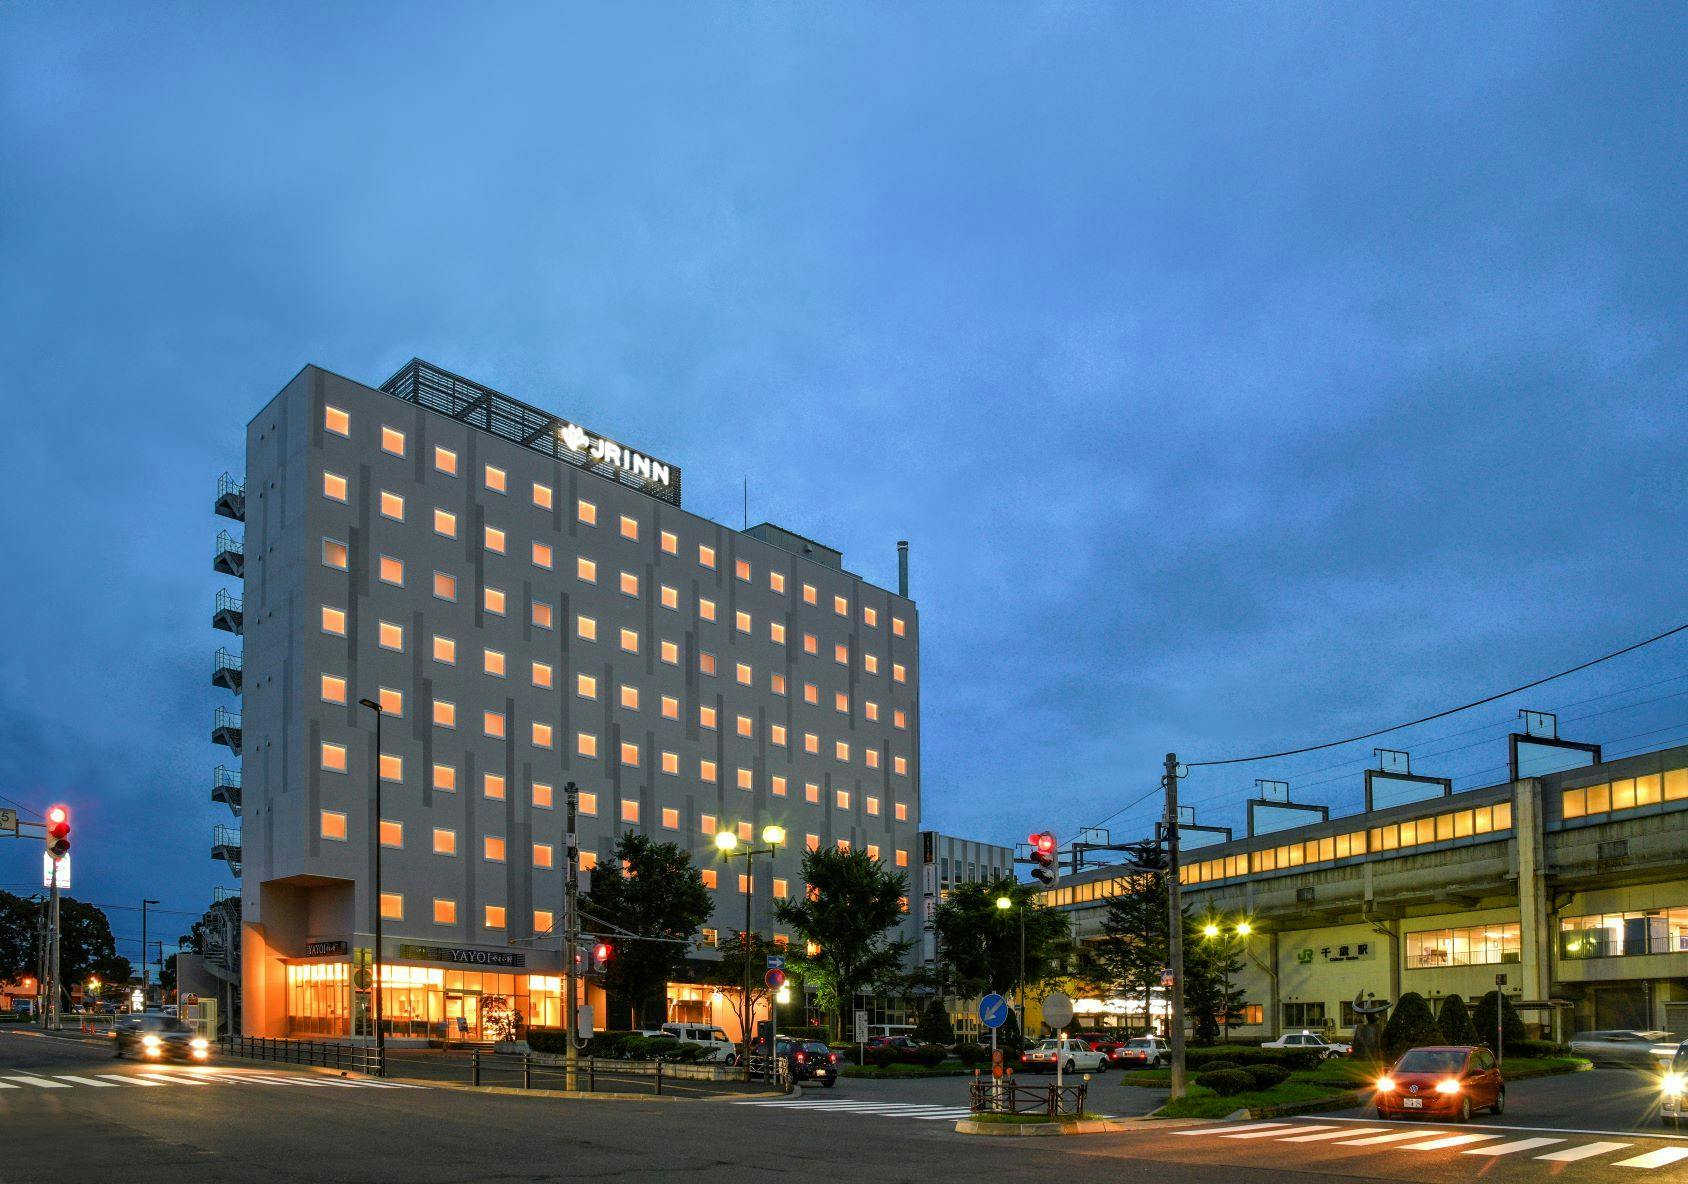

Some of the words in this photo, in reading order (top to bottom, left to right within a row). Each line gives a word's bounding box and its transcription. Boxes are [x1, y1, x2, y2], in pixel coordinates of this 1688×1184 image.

[309, 943, 326, 955] YAYOI
[1297, 948, 1313, 960] JR
[451, 949, 492, 963] YAYOI
